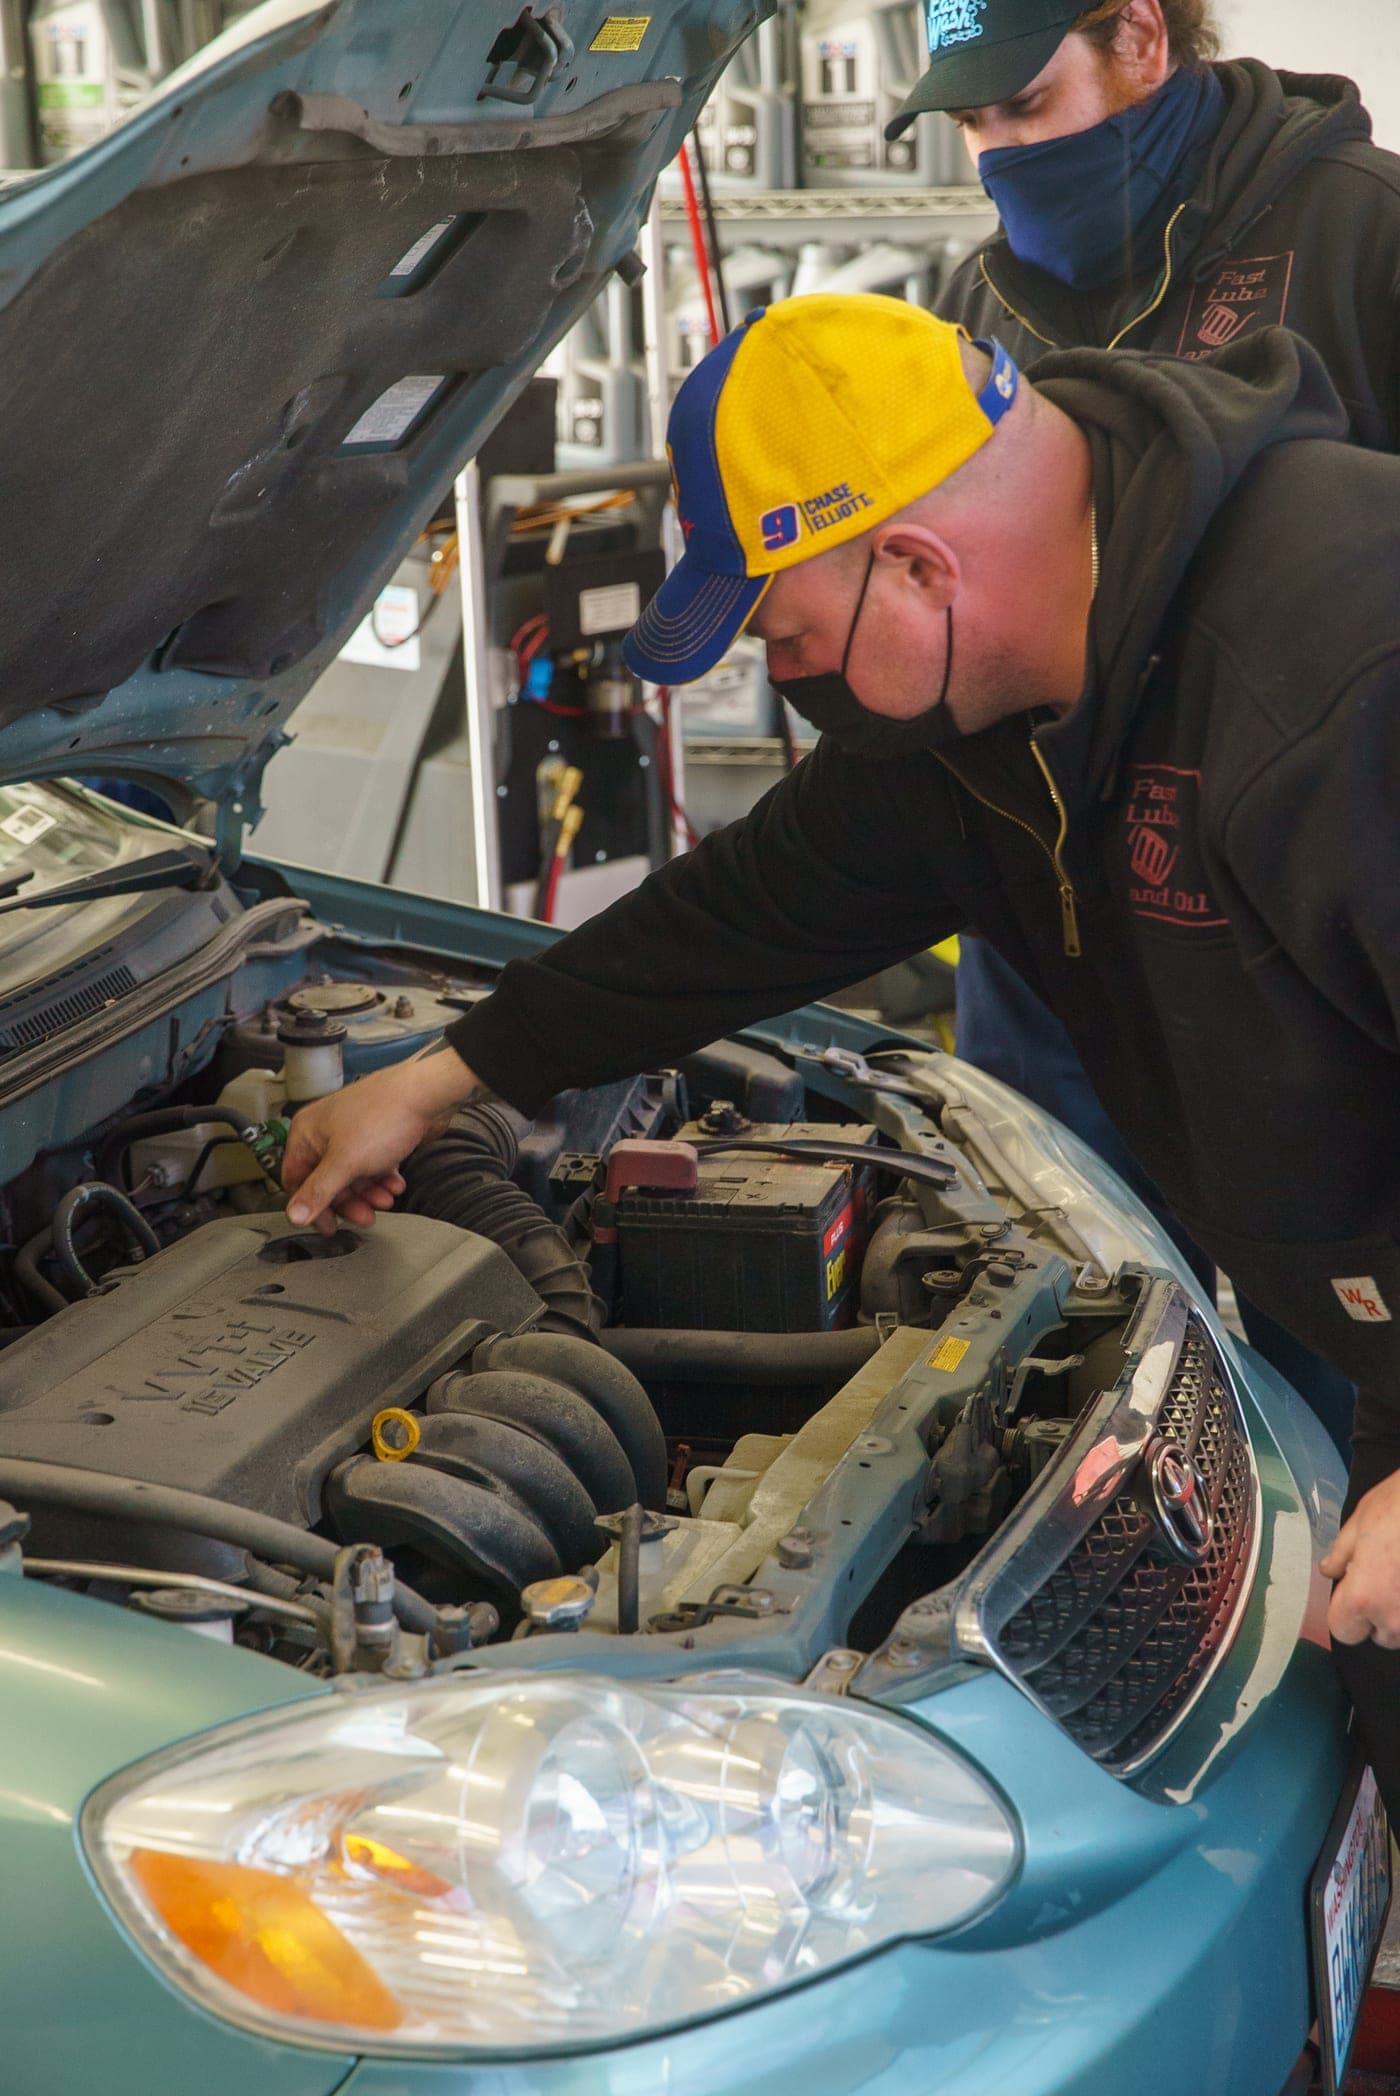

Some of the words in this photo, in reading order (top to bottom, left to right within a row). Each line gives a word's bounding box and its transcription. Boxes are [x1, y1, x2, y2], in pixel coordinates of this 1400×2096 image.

[927, 9, 972, 53] Wash
[1216, 269, 1266, 285] Fast
[1207, 287, 1268, 303] Lube
[804, 483, 852, 514] CHASE
[760, 503, 800, 551] 9
